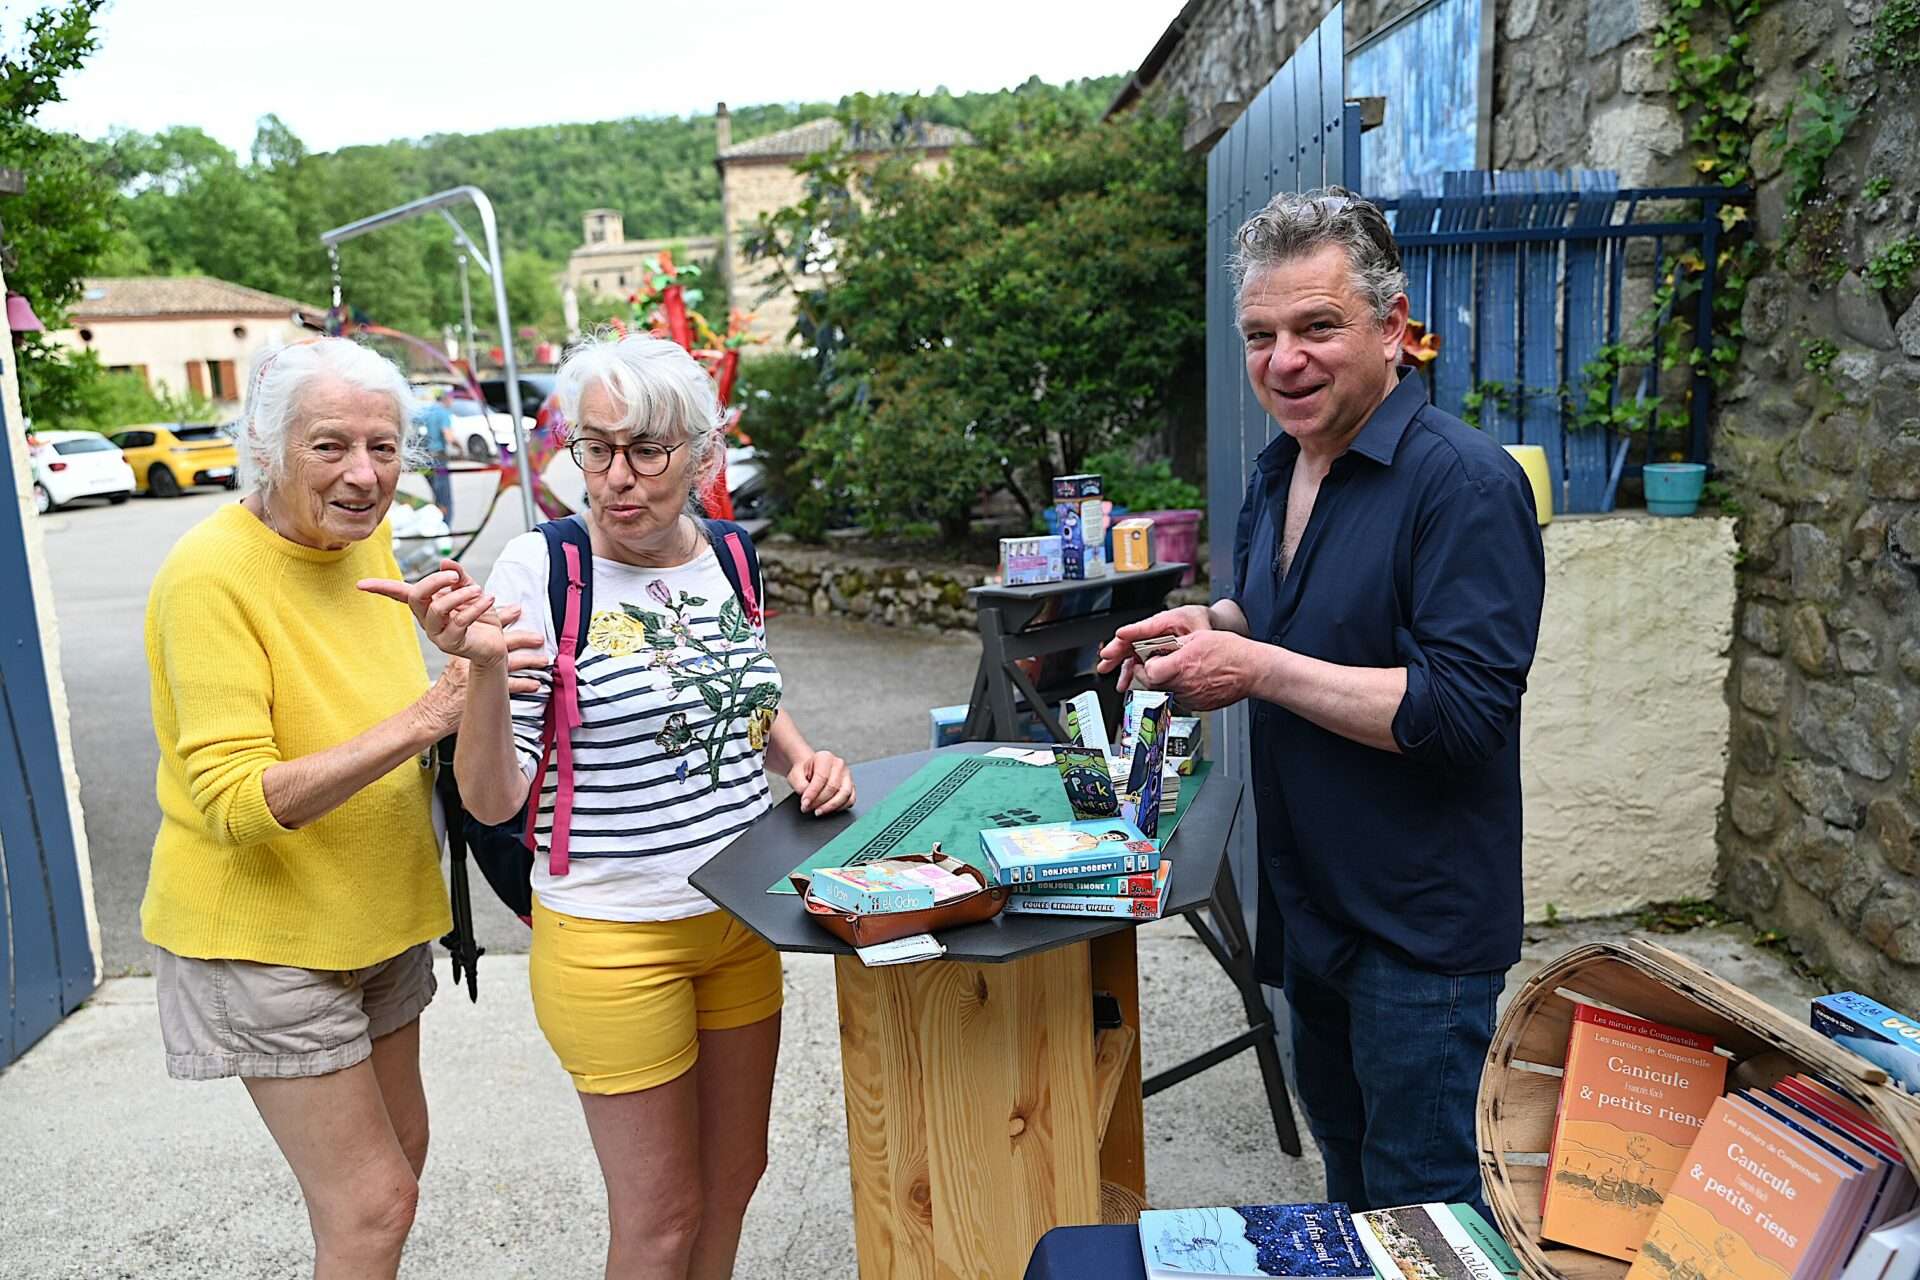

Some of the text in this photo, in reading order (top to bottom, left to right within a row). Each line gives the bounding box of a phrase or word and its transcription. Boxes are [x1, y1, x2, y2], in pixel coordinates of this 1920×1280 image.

[1042, 867, 1078, 876] BONJOUR
[1081, 863, 1112, 873] ROBERT
[1076, 882, 1104, 890] SIMONE
[1593, 1014, 1699, 1047] Les miroirs de Compostelle
[1594, 1032, 1711, 1068] Les miroirs de Compostelle
[1608, 1056, 1689, 1089] Canicule
[1580, 1085, 1705, 1128] & petits riens
[1723, 1113, 1737, 1127] Les
[1727, 1143, 1797, 1200] Canicule
[1690, 1163, 1705, 1181] &
[1704, 1177, 1753, 1216] petits
[1755, 1211, 1799, 1248] riens
[1303, 1213, 1327, 1241] Enfin
[1313, 1242, 1334, 1262] seul
[1454, 1245, 1492, 1280] Malle
